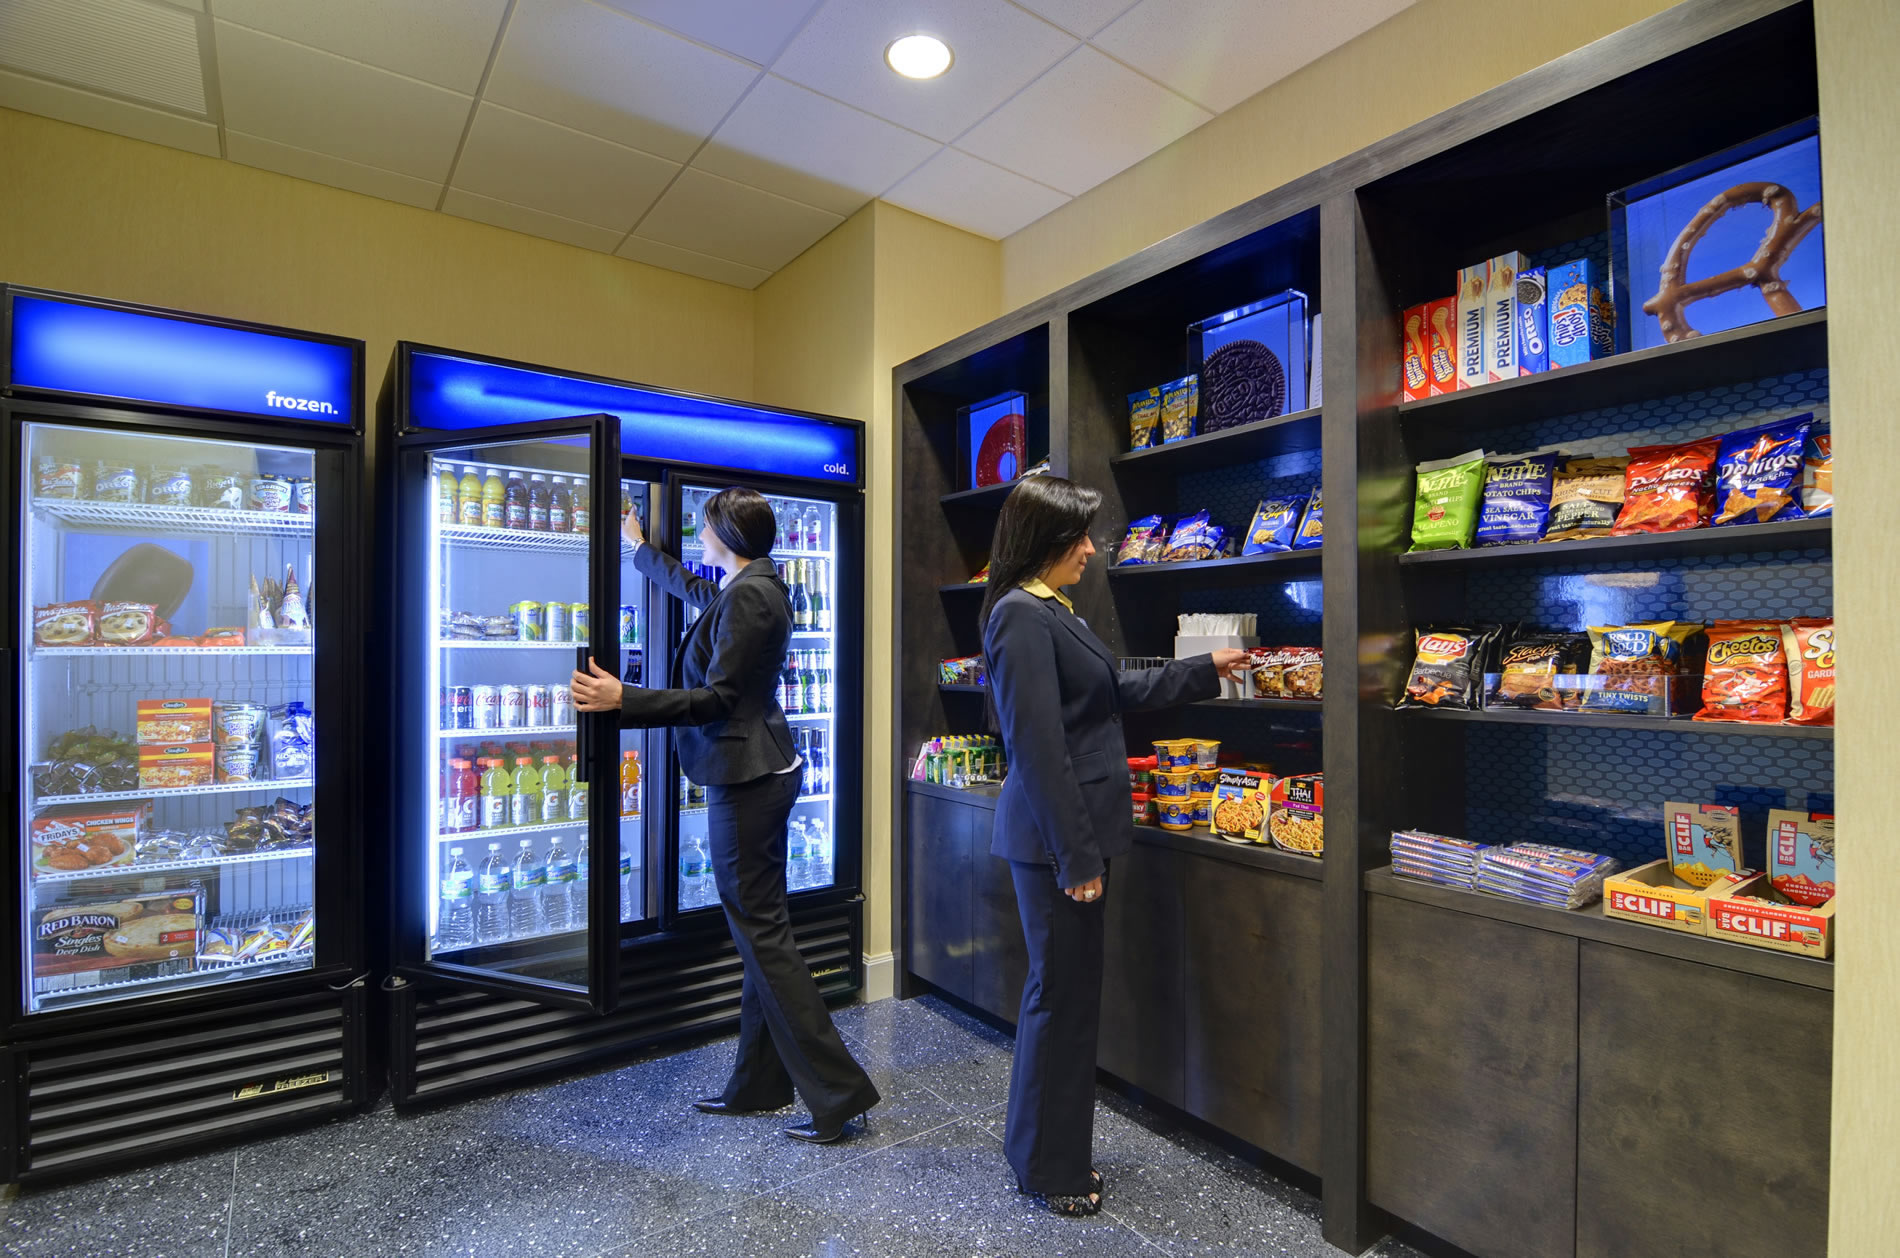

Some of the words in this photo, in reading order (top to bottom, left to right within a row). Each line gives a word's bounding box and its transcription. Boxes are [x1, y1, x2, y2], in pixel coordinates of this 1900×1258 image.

[1496, 298, 1510, 369] PREMIUM
[1523, 307, 1544, 355] OREO
[1555, 317, 1575, 346] Chips
[1466, 308, 1480, 377] PREMIUM
[1411, 356, 1426, 381] Butter
[1431, 354, 1445, 381] Nutter
[1438, 349, 1455, 374] Butter
[1405, 361, 1419, 388] Nutter
[265, 390, 339, 415] frozen.
[1214, 382, 1250, 414] OREO
[823, 462, 850, 476] cold.
[1722, 453, 1800, 479] Doritos
[1500, 481, 1524, 489] BRAND
[1515, 488, 1542, 496] CHIPS
[1633, 484, 1660, 493] Nacho
[1482, 511, 1536, 523] VINEGAR
[1485, 506, 1501, 514] SEA
[1557, 510, 1600, 523] PEPPER
[1708, 636, 1778, 664] Cheetos
[1413, 667, 1452, 679] Barbecue
[1598, 691, 1617, 699] TINY
[1619, 692, 1649, 703] TWISTS
[1219, 773, 1242, 786] Simply
[1241, 776, 1259, 788] Asia
[1290, 787, 1312, 800] THAI
[86, 818, 113, 827] CHICKEN
[114, 816, 134, 825] WINGS
[1676, 813, 1692, 846] CLIF
[1779, 821, 1797, 855] CLIF
[1778, 855, 1795, 863] BAR
[1783, 887, 1808, 895] ALMOND
[1785, 882, 1827, 893] CHOCOLATE
[1615, 893, 1624, 908] BAR
[1624, 895, 1672, 917] CLIF
[1721, 912, 1731, 929] BAR
[1723, 903, 1760, 913] CHOCOLATE
[1761, 910, 1787, 918] ALMOND
[1788, 914, 1810, 922] FUDGE
[40, 917, 69, 937] RED
[71, 913, 117, 928] BARON
[1731, 915, 1787, 938] CLIF
[54, 934, 102, 948] Singles
[55, 946, 79, 957] Deep
[80, 943, 101, 954] Dish
